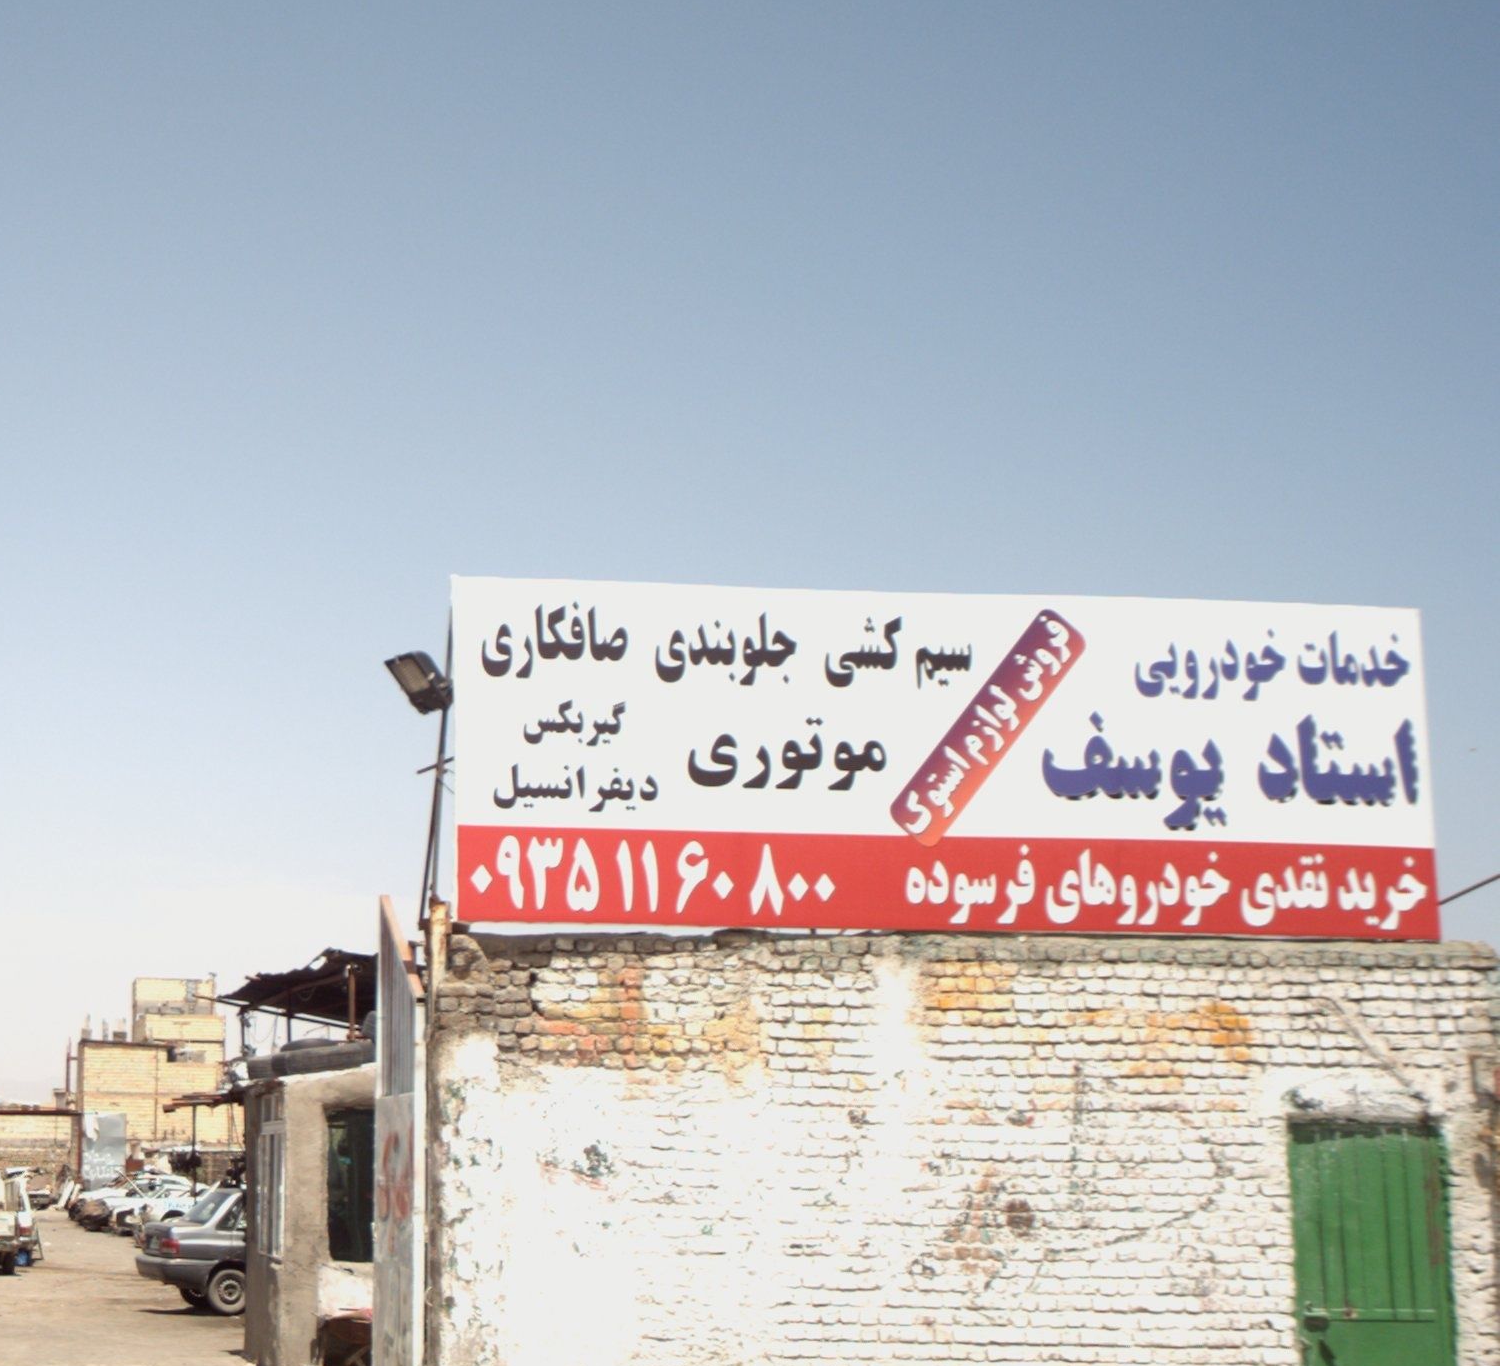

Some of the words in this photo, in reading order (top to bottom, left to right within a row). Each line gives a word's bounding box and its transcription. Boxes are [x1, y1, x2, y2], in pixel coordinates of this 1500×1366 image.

[481, 601, 629, 678] صافکاری
[655, 612, 797, 686] جلوبندی
[824, 616, 902, 687] کشی
[916, 643, 972, 689] سیم
[1014, 615, 1072, 701] فروش
[1135, 629, 1286, 700] خودرویی
[1298, 629, 1410, 687] خدمات
[523, 700, 626, 746] گیربکس
[688, 717, 887, 790] موتوری
[965, 684, 1020, 765] لوازم
[1258, 713, 1419, 806] استاد
[493, 763, 658, 812] دیفرانسیل
[903, 745, 971, 834] استوک
[1041, 711, 1227, 831] یوسف
[905, 845, 1036, 924] فرسوده
[1044, 848, 1230, 926] خودروهای
[1240, 854, 1329, 926] نقدی
[1337, 856, 1428, 929] خرید
